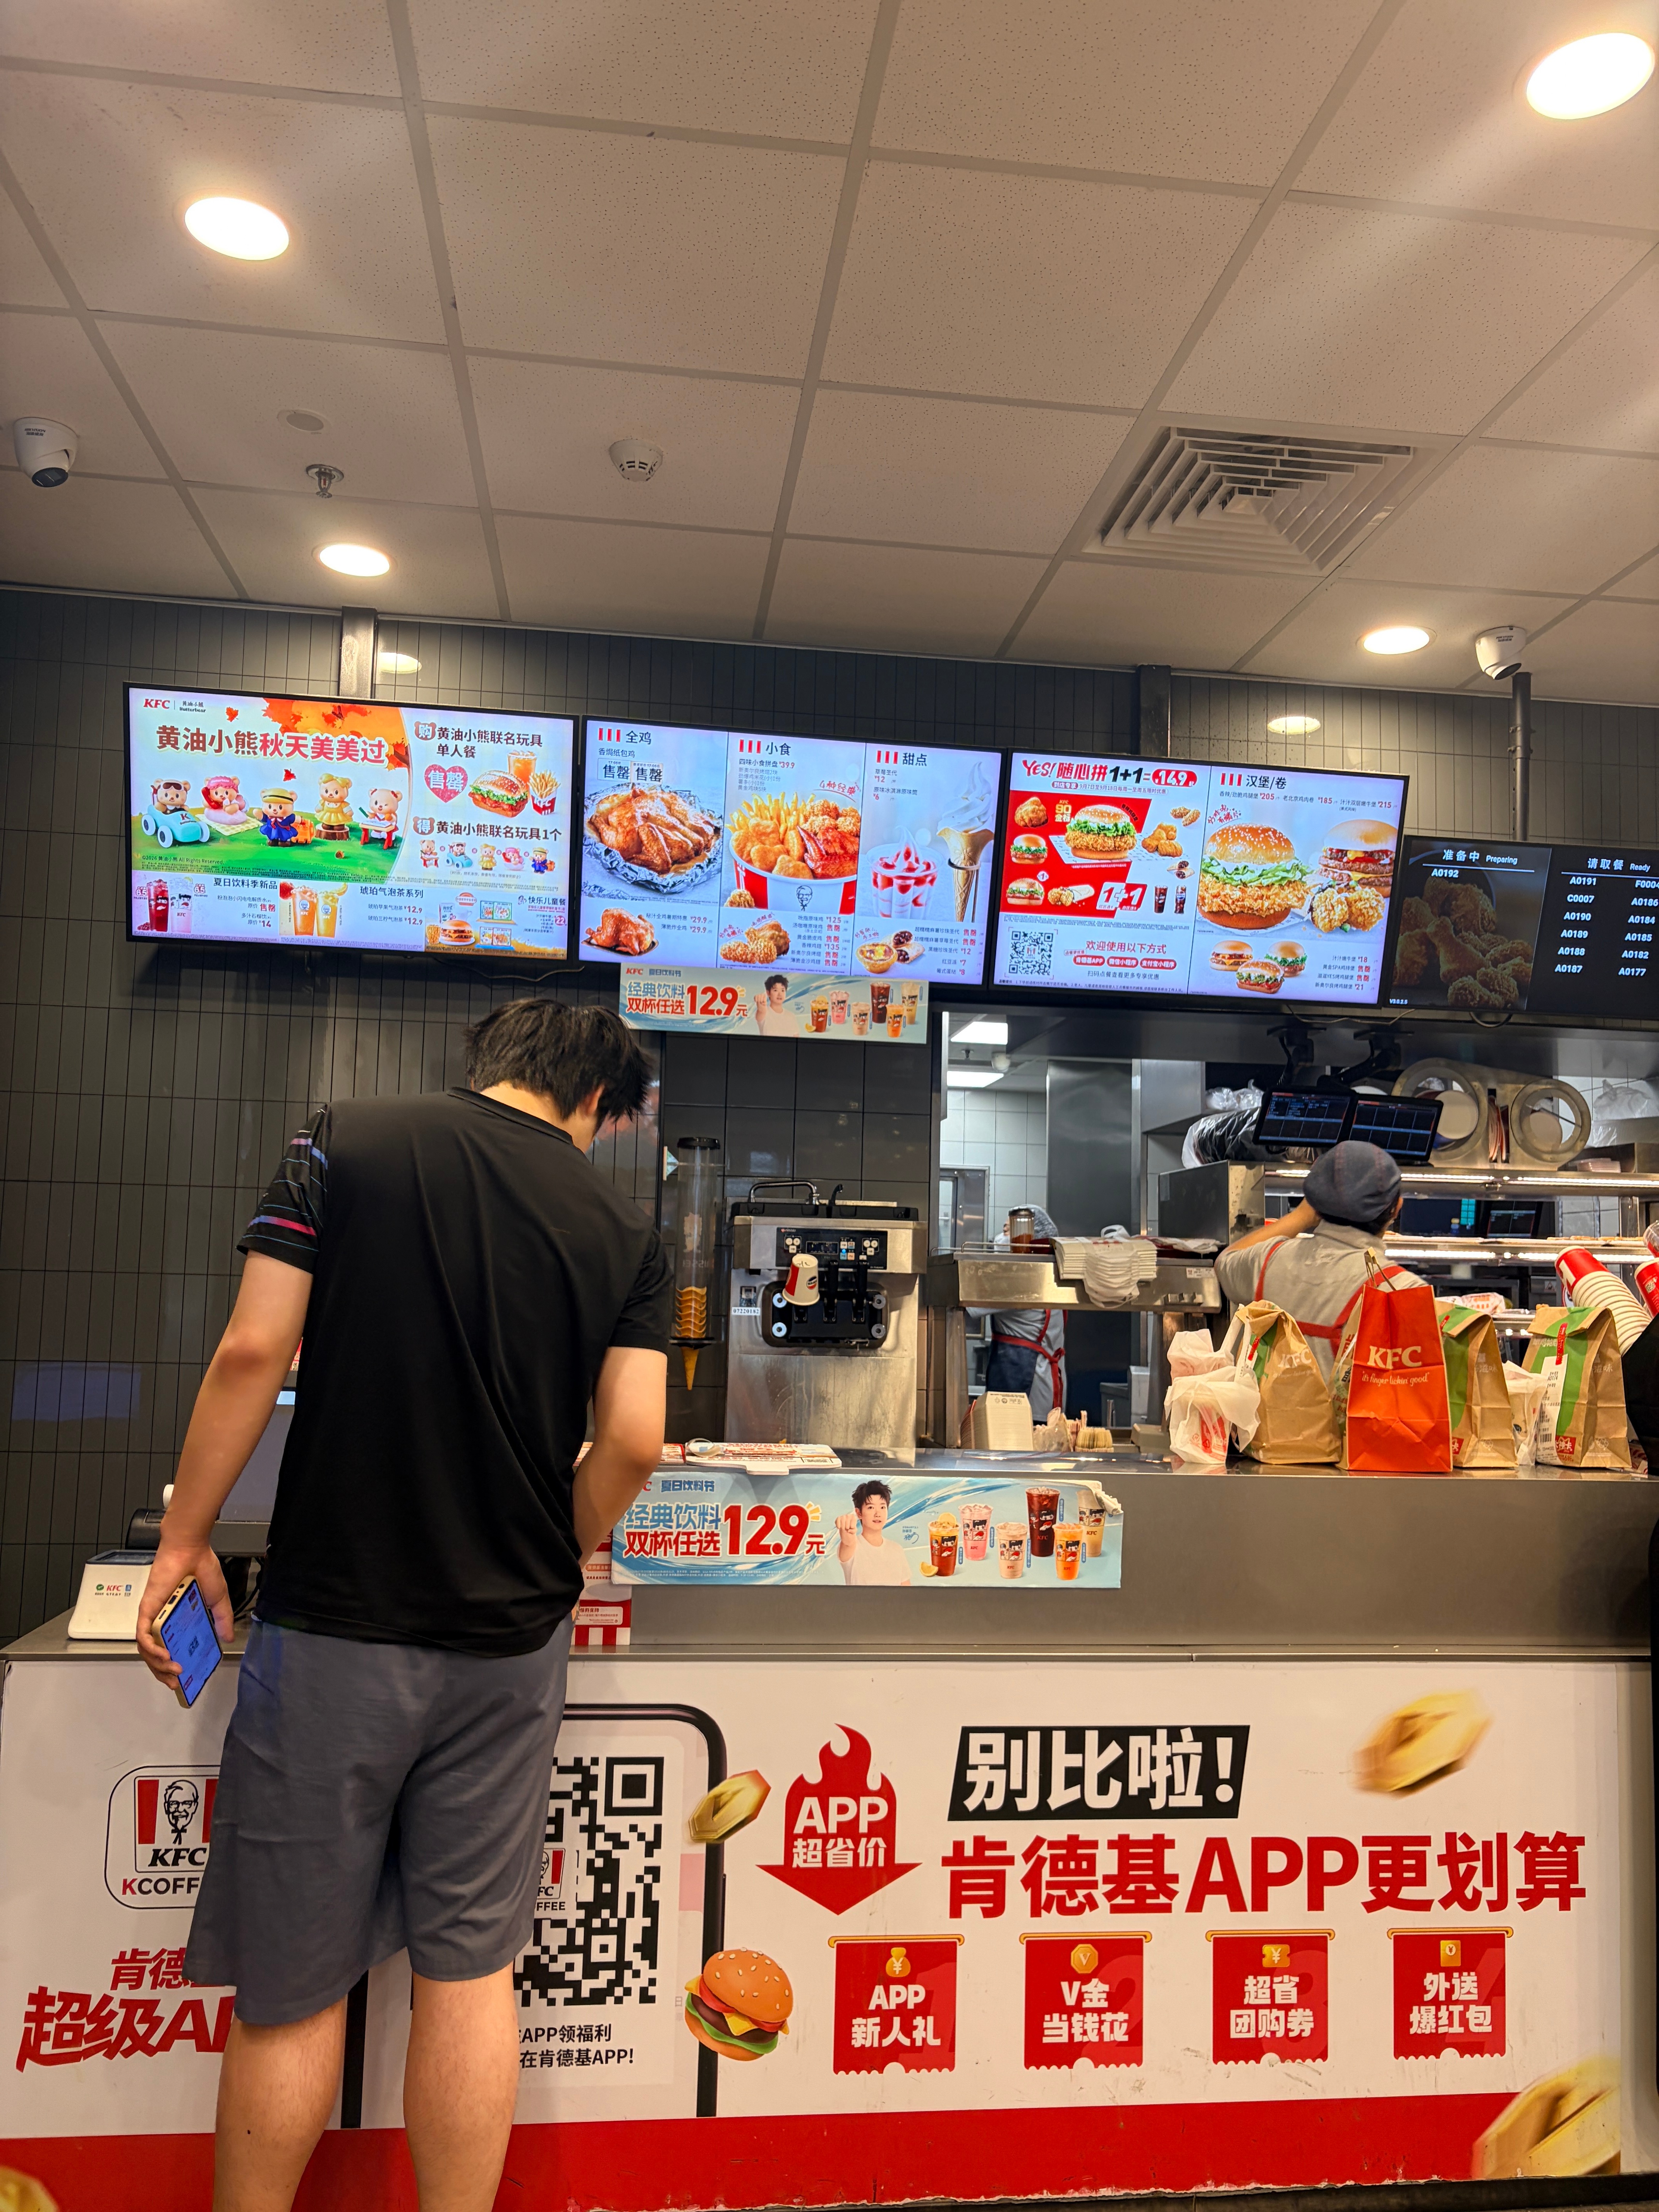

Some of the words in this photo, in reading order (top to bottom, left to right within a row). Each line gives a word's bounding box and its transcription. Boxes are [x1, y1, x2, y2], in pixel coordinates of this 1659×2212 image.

[144, 699, 170, 709] KFC
[418, 724, 432, 738] 购
[437, 726, 543, 747] 黄油小熊联名玩具
[626, 730, 652, 745] 全鸡
[156, 725, 385, 765] 黄油小熊秋天美美过
[436, 744, 476, 759] 单人餐
[765, 742, 791, 756] 小食
[739, 758, 778, 768] 四味小食拼盘
[902, 752, 927, 766] 甜点
[603, 764, 630, 780] 售罄
[635, 767, 663, 783] 售罄
[1022, 760, 1055, 778] YES!
[1056, 761, 1108, 782] 随心拼
[428, 770, 464, 792] 售罄
[1246, 775, 1287, 790] 汉堡/卷
[1055, 804, 1072, 814] 90
[417, 820, 431, 834] 得
[436, 821, 562, 841] 黄油小熊联名玩具1个
[1443, 849, 1480, 862] 准备中
[1486, 855, 1518, 865] Preparing
[1587, 858, 1624, 871] 请取餐
[1630, 863, 1650, 872] Ready
[1431, 869, 1459, 878] A0192
[1570, 876, 1597, 886] A0191
[213, 877, 278, 890] 夏日饮料季新品
[360, 886, 424, 898] 琥珀气泡茶系列
[1567, 894, 1594, 903] C0007
[404, 905, 422, 914] ¥12.9
[1631, 897, 1659, 907] A0186
[404, 917, 423, 926] ¥12.9
[1564, 912, 1591, 921] A0190
[1628, 915, 1656, 924] A0184
[1561, 929, 1588, 939] A0189
[1625, 933, 1652, 942] A0185
[1086, 940, 1167, 955] 欢迎使用以下方式
[1558, 947, 1585, 956] A0188
[1621, 950, 1649, 959] A0182
[1554, 964, 1582, 974] A0187
[1618, 968, 1646, 977] A0177
[627, 981, 685, 999] 经典饮料
[627, 997, 685, 1015] 双杯任选
[687, 985, 739, 1017] 12.9
[736, 1005, 748, 1017] 元
[1278, 1348, 1312, 1368] KFC
[1367, 1345, 1422, 1369] KFC
[1370, 1372, 1389, 1386] finger
[661, 1480, 715, 1492] 夏日饮料节
[625, 1502, 721, 1530] 经典饮料
[624, 1531, 721, 1558] 双杯任选
[724, 1504, 809, 1555] 12.9
[805, 1534, 825, 1554] 元
[963, 1728, 1235, 1812] 别比啦!
[793, 1796, 888, 1834] APP
[148, 1848, 206, 1867] KFC
[792, 1837, 886, 1869] 超省价
[941, 1830, 1586, 1919] 肯德基APP更划算
[122, 1877, 200, 1896] KCOFF
[538, 1886, 554, 1896] FC
[536, 1901, 565, 1911] FFEE
[1061, 1978, 1109, 2008] V金
[1243, 1975, 1300, 2005] 超省
[1424, 1972, 1478, 2001] 外送
[869, 1984, 926, 2010] APP
[1230, 2009, 1314, 2039] 团购券
[1410, 2004, 1492, 2035] 爆红包
[851, 2016, 941, 2047] 新人礼
[1042, 2012, 1129, 2044] 当钱花
[520, 2048, 634, 2069] 在肯德基APP!
